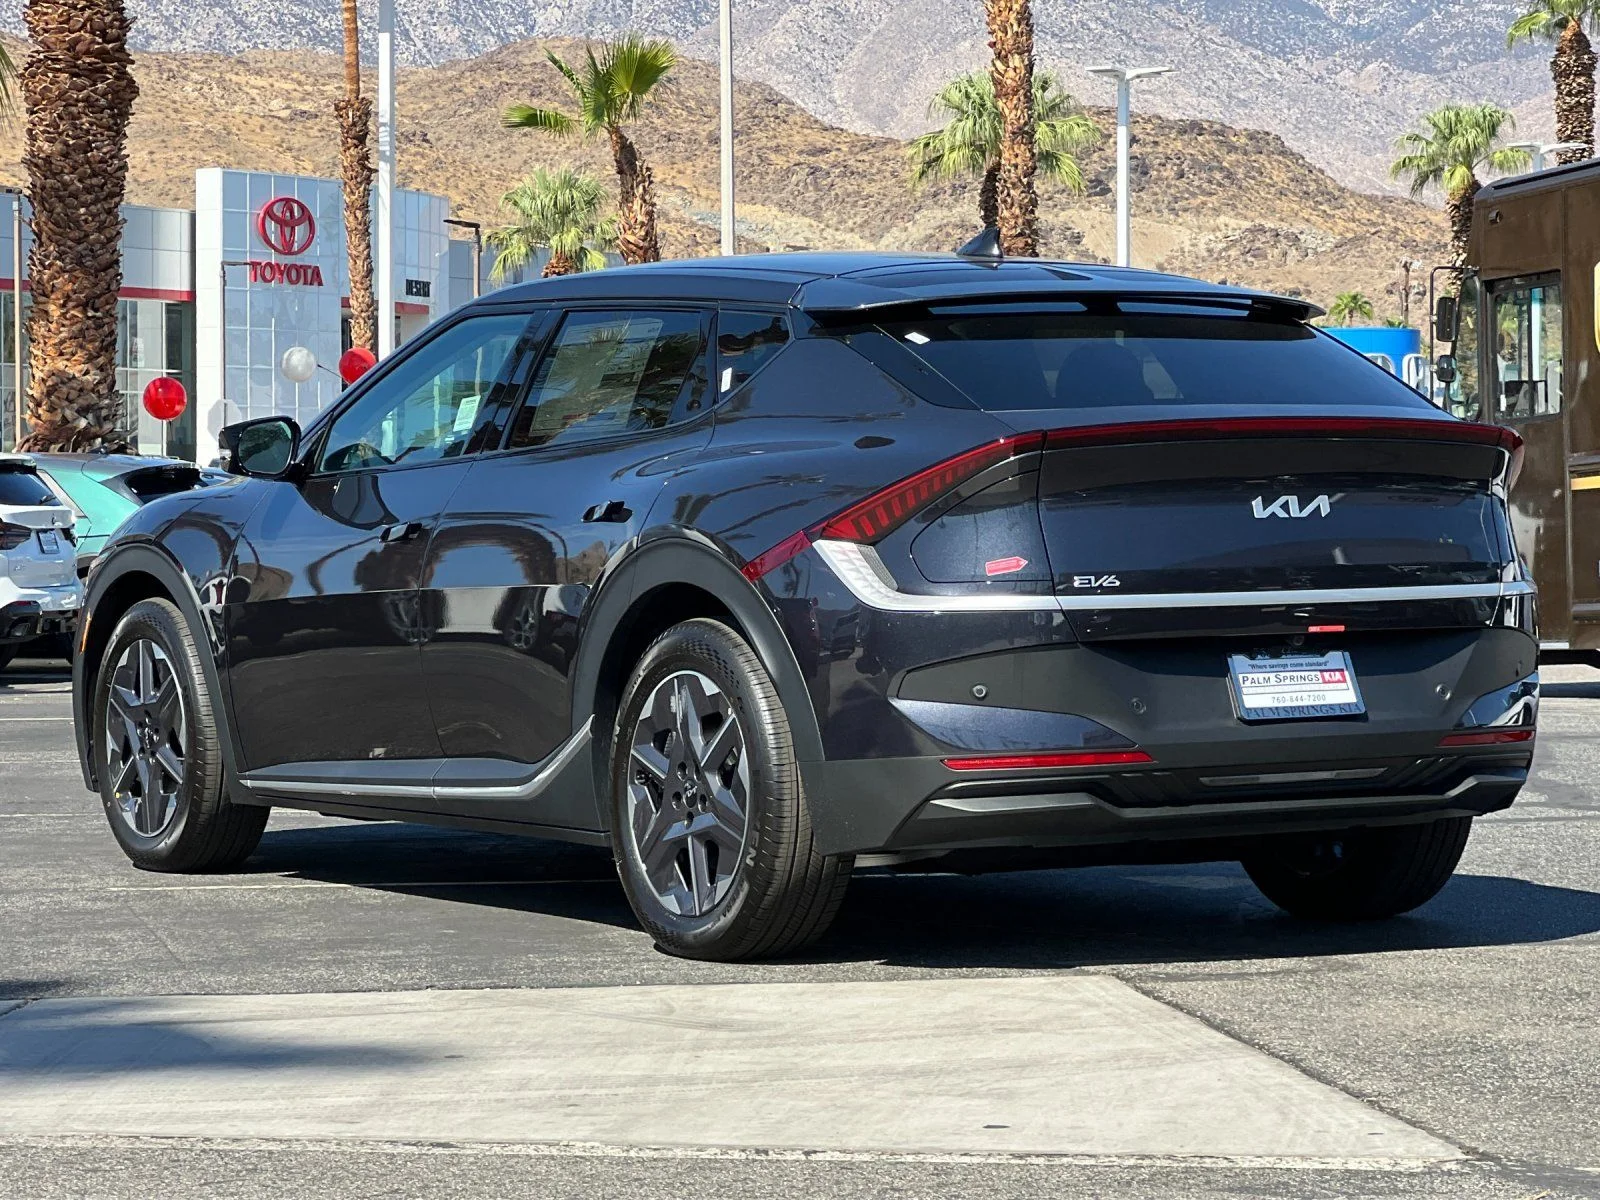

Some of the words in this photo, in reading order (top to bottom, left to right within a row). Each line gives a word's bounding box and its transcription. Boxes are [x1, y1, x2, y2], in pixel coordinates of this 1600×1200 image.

[249, 260, 324, 287] TOYOTA
[405, 278, 432, 298] DESERT
[1252, 494, 1331, 519] KIA
[1073, 574, 1121, 588] EV6
[1268, 662, 1288, 670] savings
[1242, 674, 1271, 685] PALM
[1274, 673, 1320, 684] SPRINGS
[1324, 671, 1344, 682] KIA
[1246, 708, 1281, 718] PALM
[1283, 705, 1336, 717] SPRINGS
[1338, 703, 1362, 714] KIA
